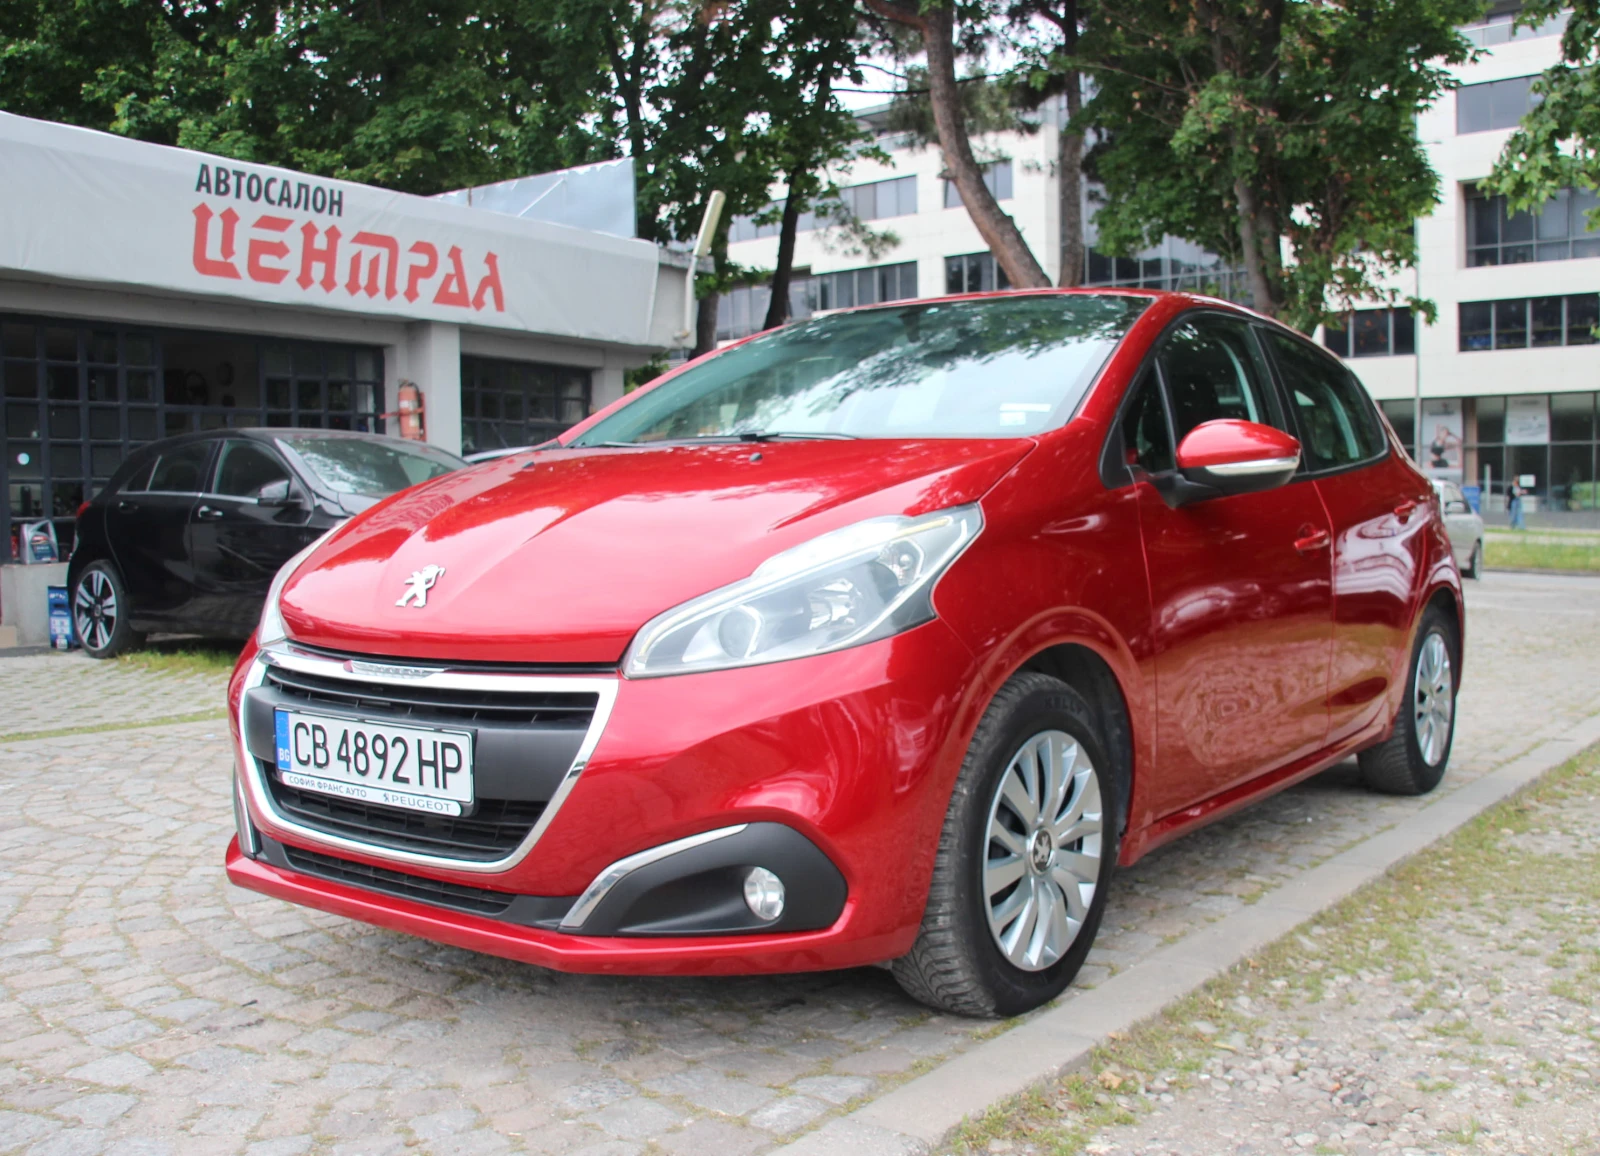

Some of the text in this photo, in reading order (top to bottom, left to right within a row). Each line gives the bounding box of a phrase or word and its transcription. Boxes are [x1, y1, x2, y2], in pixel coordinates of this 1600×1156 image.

[195, 163, 344, 217] АВТОСАЛОН
[192, 202, 505, 312] ЦЕНТРАЛ
[278, 747, 290, 762] BG
[337, 729, 410, 784] 4892
[289, 775, 367, 798] СОФИЯ ФРАНС АУТО
[392, 795, 451, 812] PEUGEOT
